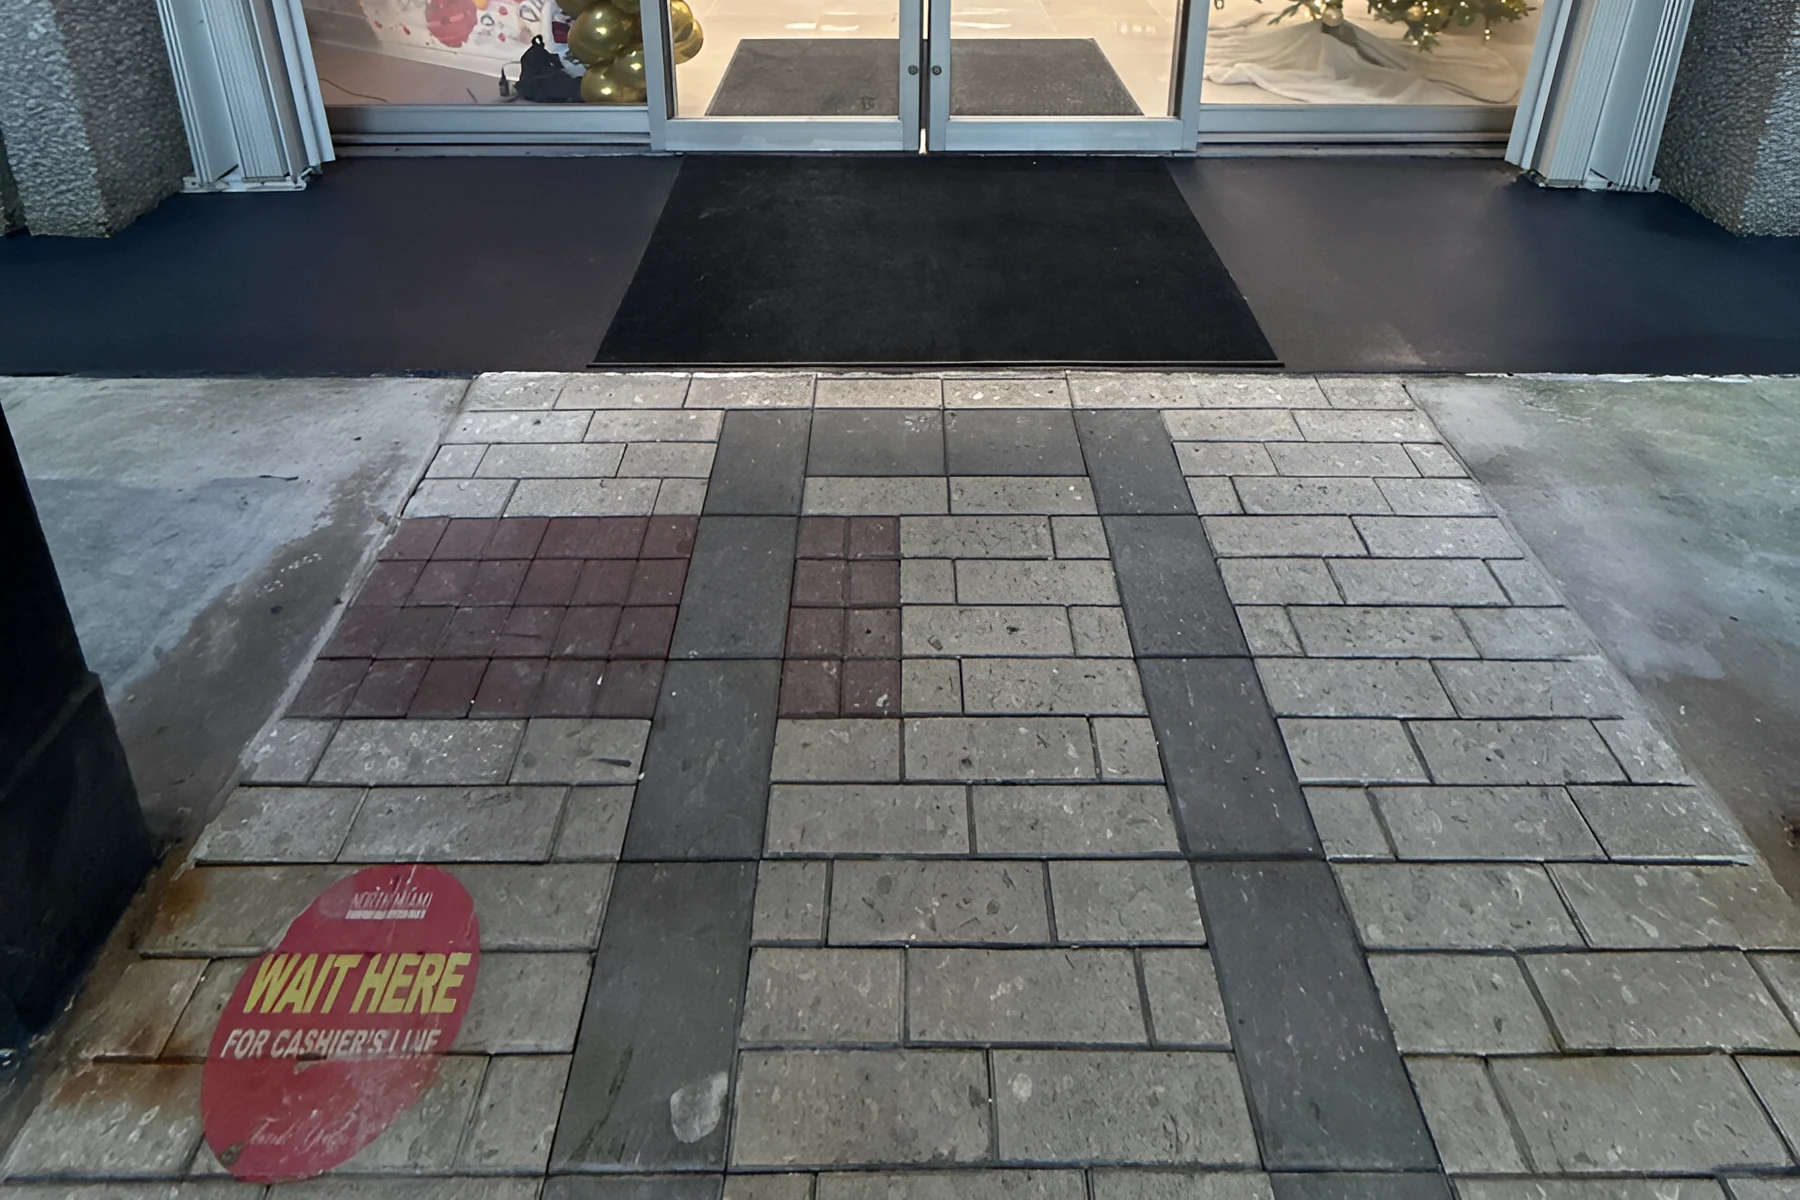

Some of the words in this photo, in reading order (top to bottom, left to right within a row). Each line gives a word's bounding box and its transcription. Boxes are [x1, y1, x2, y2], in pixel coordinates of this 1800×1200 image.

[243, 953, 363, 1014] WAIT
[349, 952, 473, 1014] HERE
[220, 1028, 271, 1059] FOR
[270, 1029, 389, 1059] CASHIER'S
